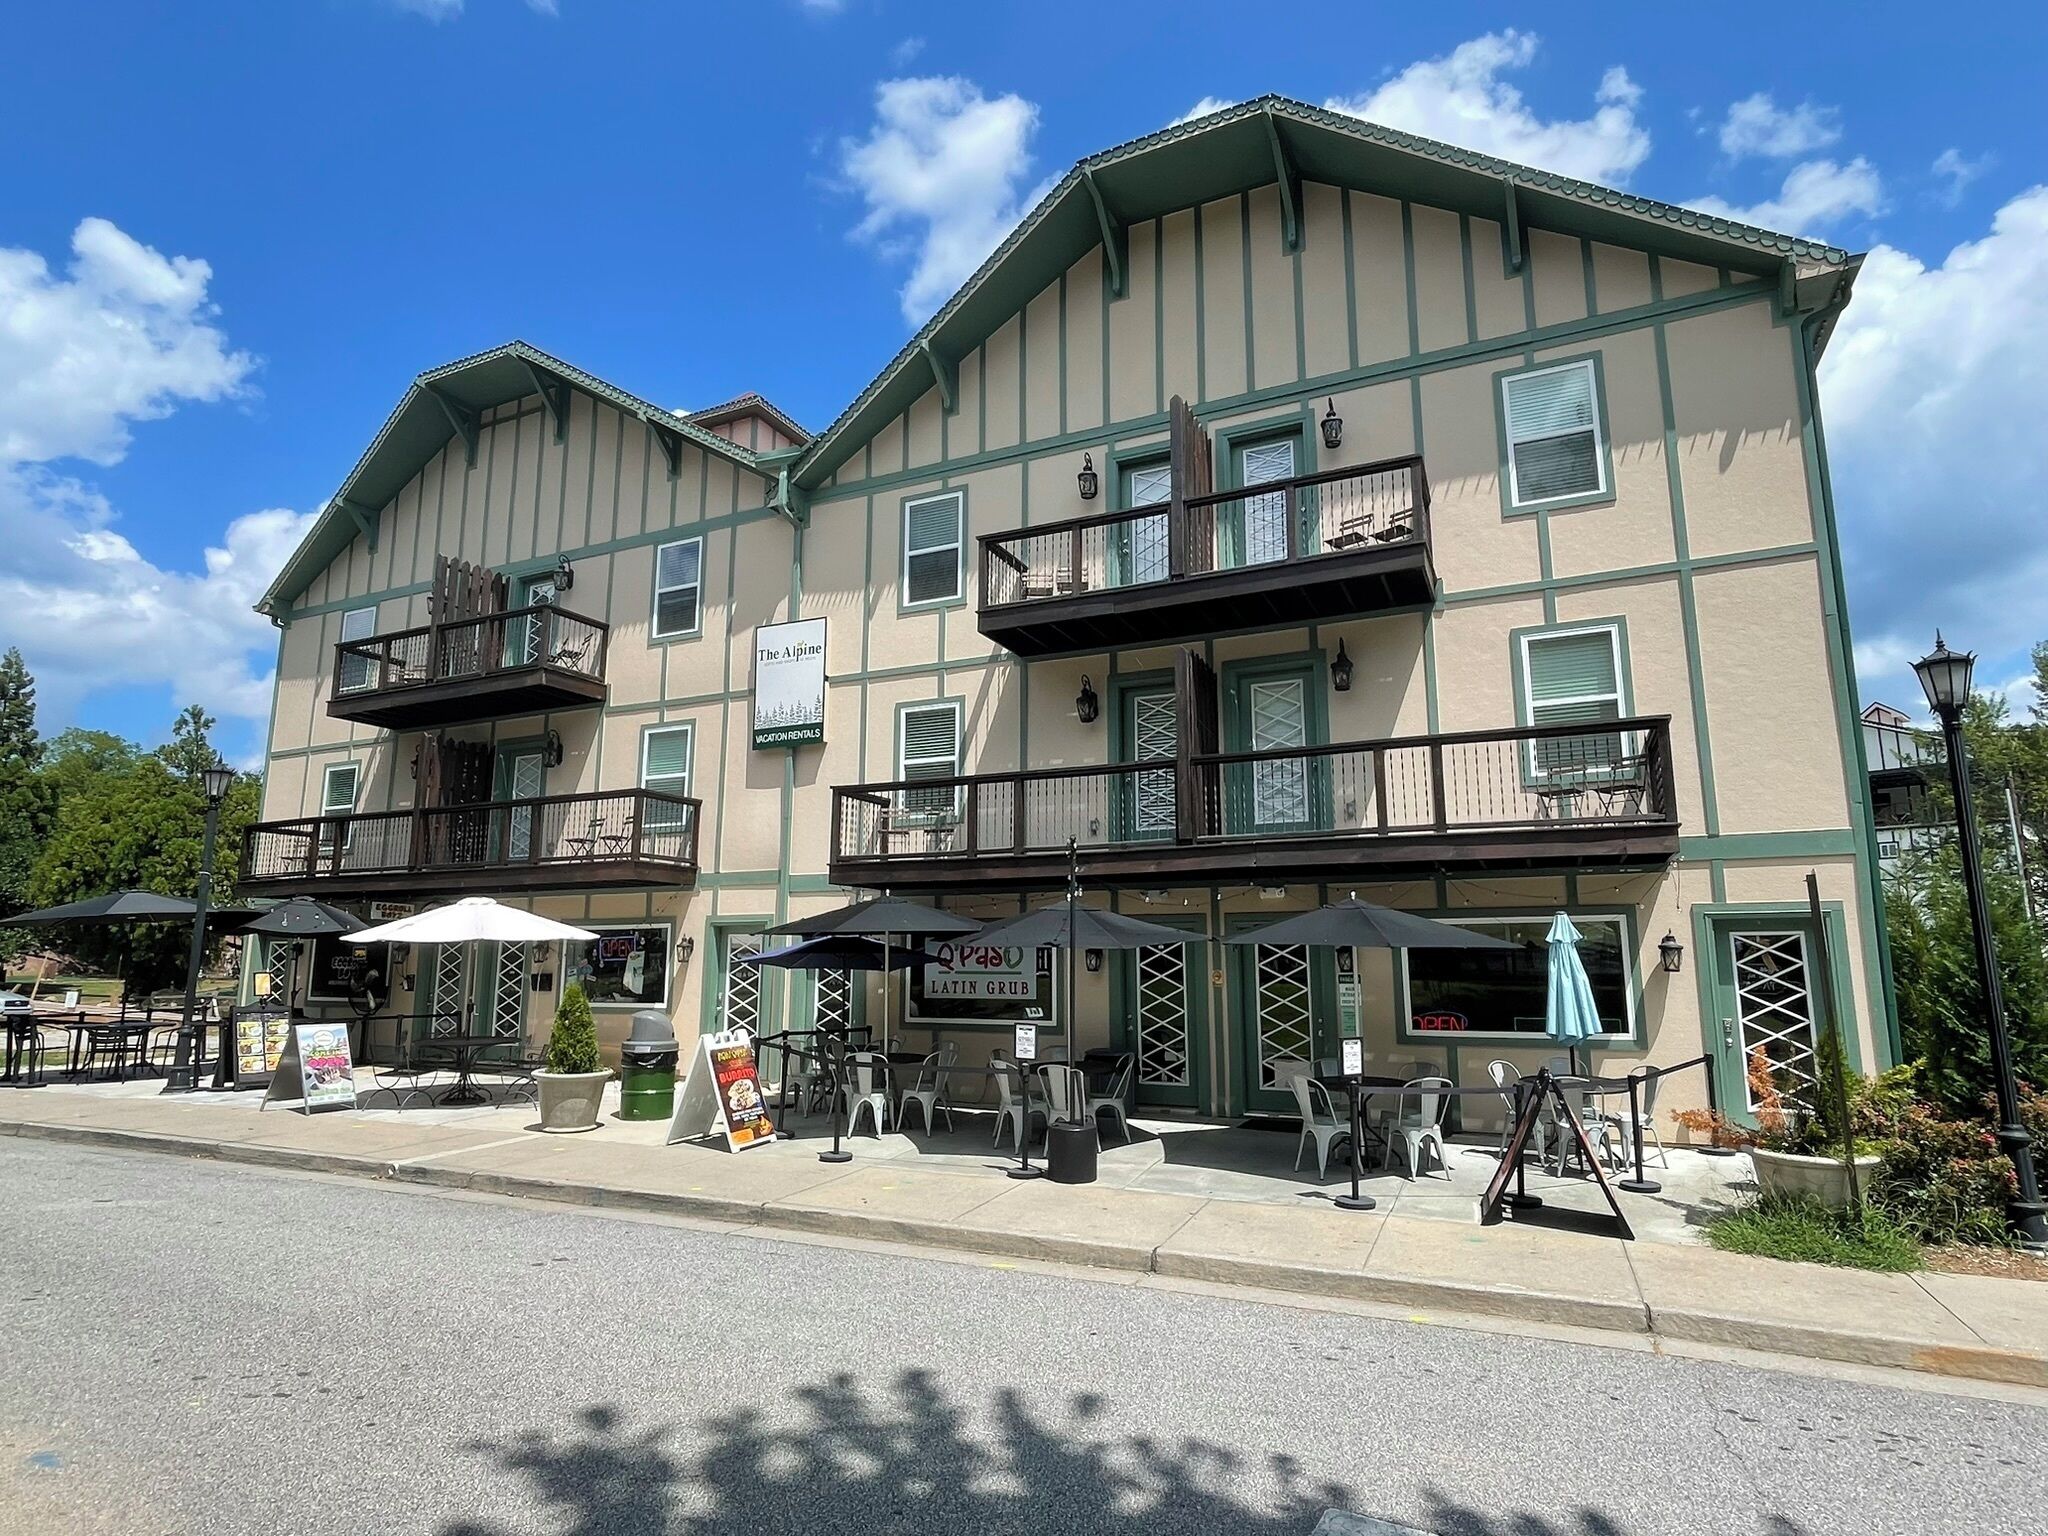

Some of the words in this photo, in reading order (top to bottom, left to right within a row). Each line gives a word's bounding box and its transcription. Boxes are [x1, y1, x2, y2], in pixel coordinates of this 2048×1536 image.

[758, 649, 780, 662] The
[782, 643, 822, 662] Alpine
[756, 731, 788, 744] VACATION
[788, 728, 821, 741] RENTALS
[602, 940, 634, 958] OPEN
[931, 980, 977, 994] LATIN
[986, 981, 1029, 995] GRUB
[719, 1067, 755, 1083] BURRITO
